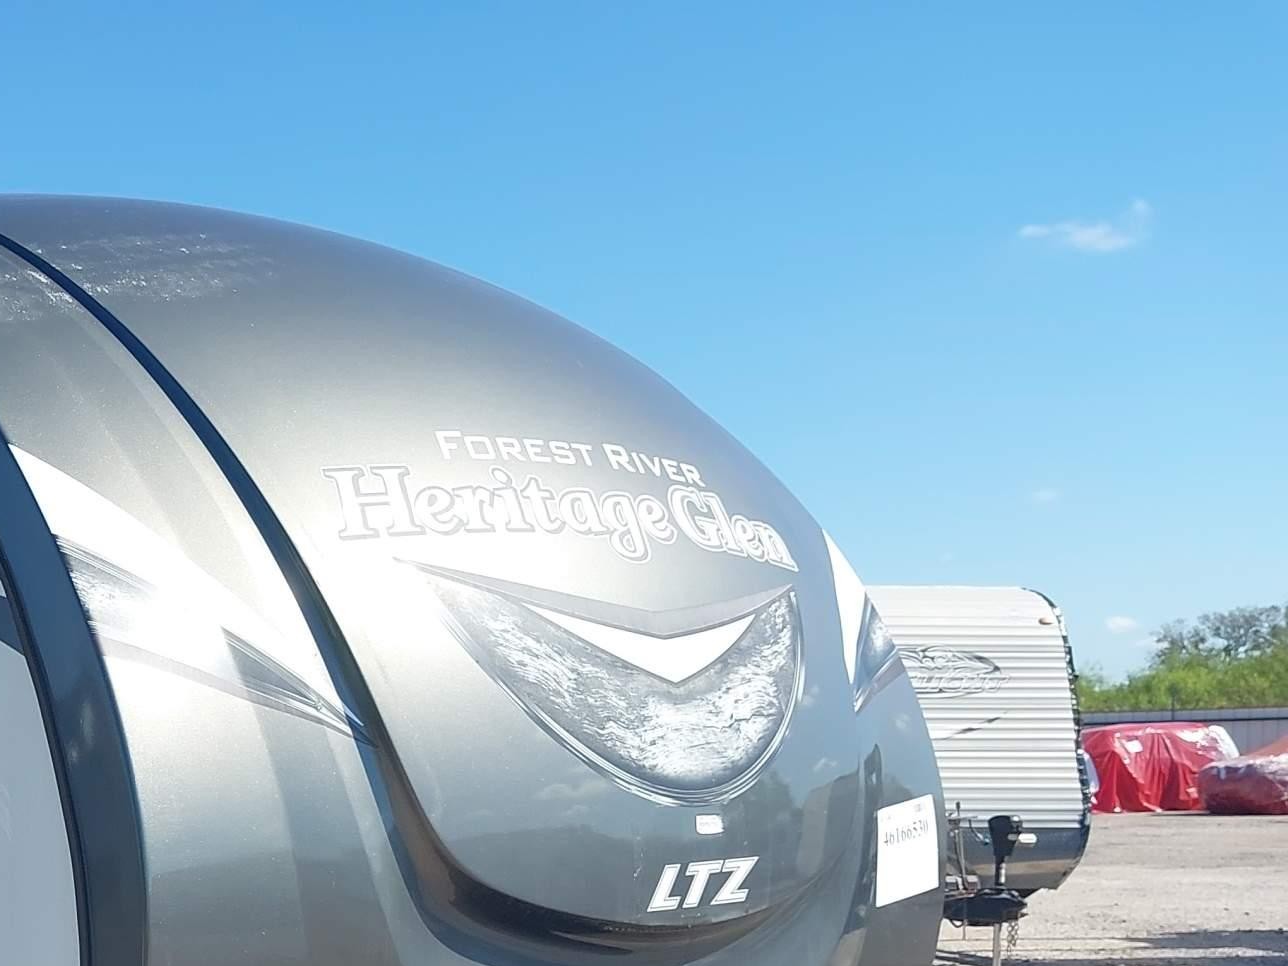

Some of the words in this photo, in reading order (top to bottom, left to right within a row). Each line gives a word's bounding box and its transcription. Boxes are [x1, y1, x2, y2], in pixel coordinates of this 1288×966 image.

[433, 430, 594, 467] FOREST
[601, 442, 707, 488] RIVER
[320, 463, 678, 564] Heritage
[667, 484, 800, 573] Glen
[646, 855, 760, 913] LTZ
